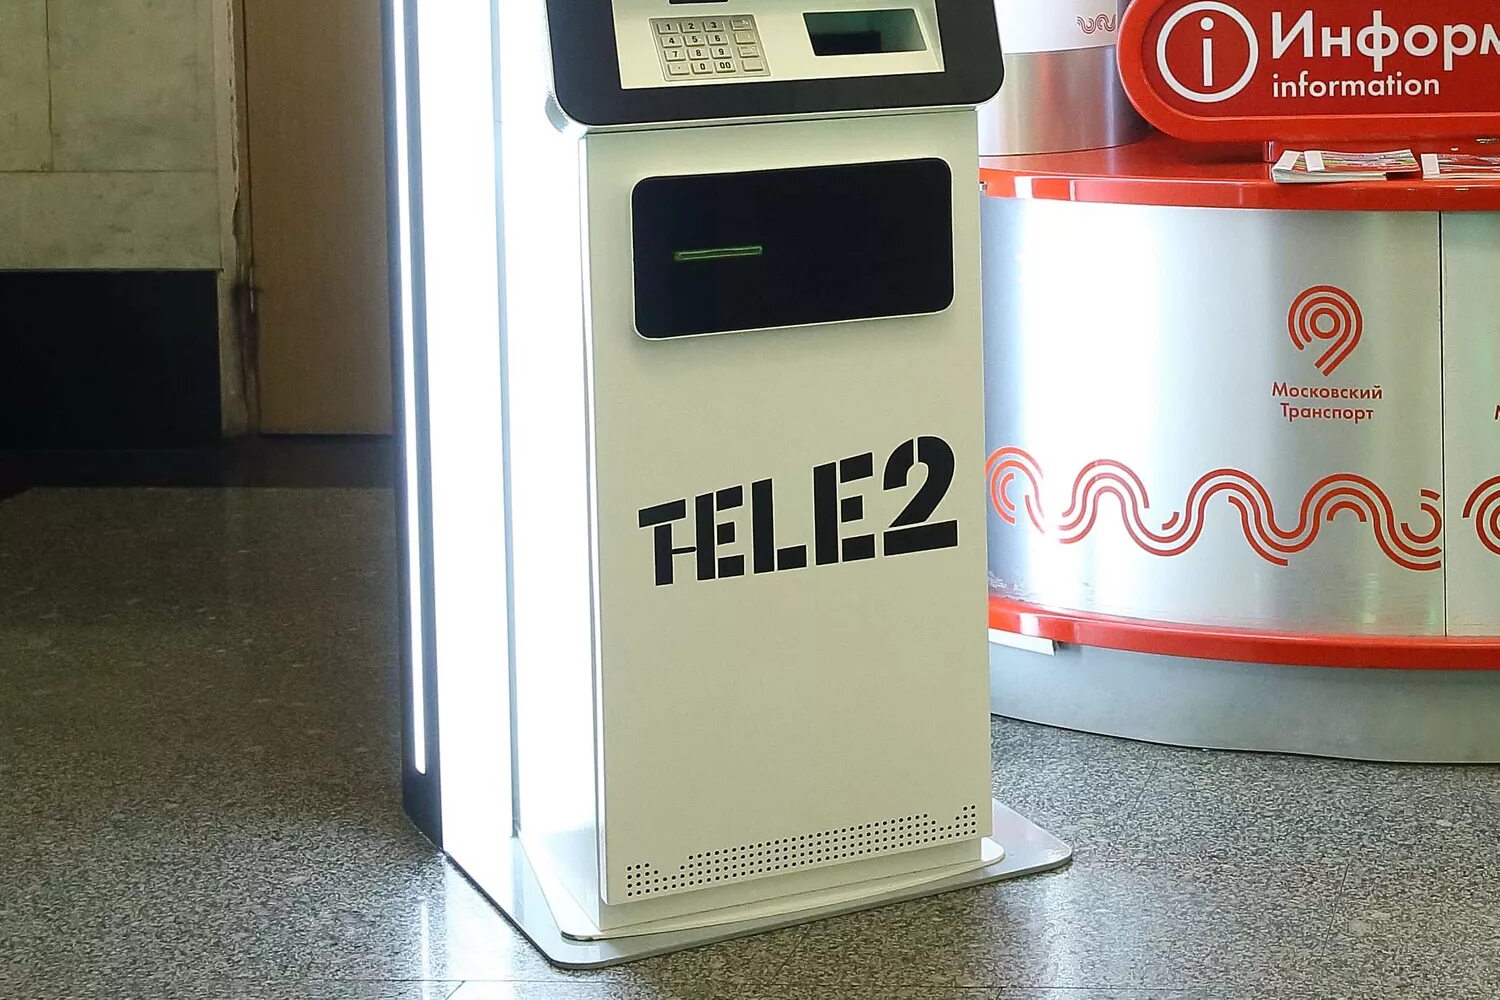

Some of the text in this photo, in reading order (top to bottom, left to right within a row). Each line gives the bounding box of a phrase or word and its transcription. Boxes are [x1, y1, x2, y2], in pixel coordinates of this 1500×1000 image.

[1271, 72, 1440, 100] information
[1271, 381, 1383, 400] Московский
[1279, 402, 1374, 423] Транспорт
[638, 435, 958, 587] TELE2
